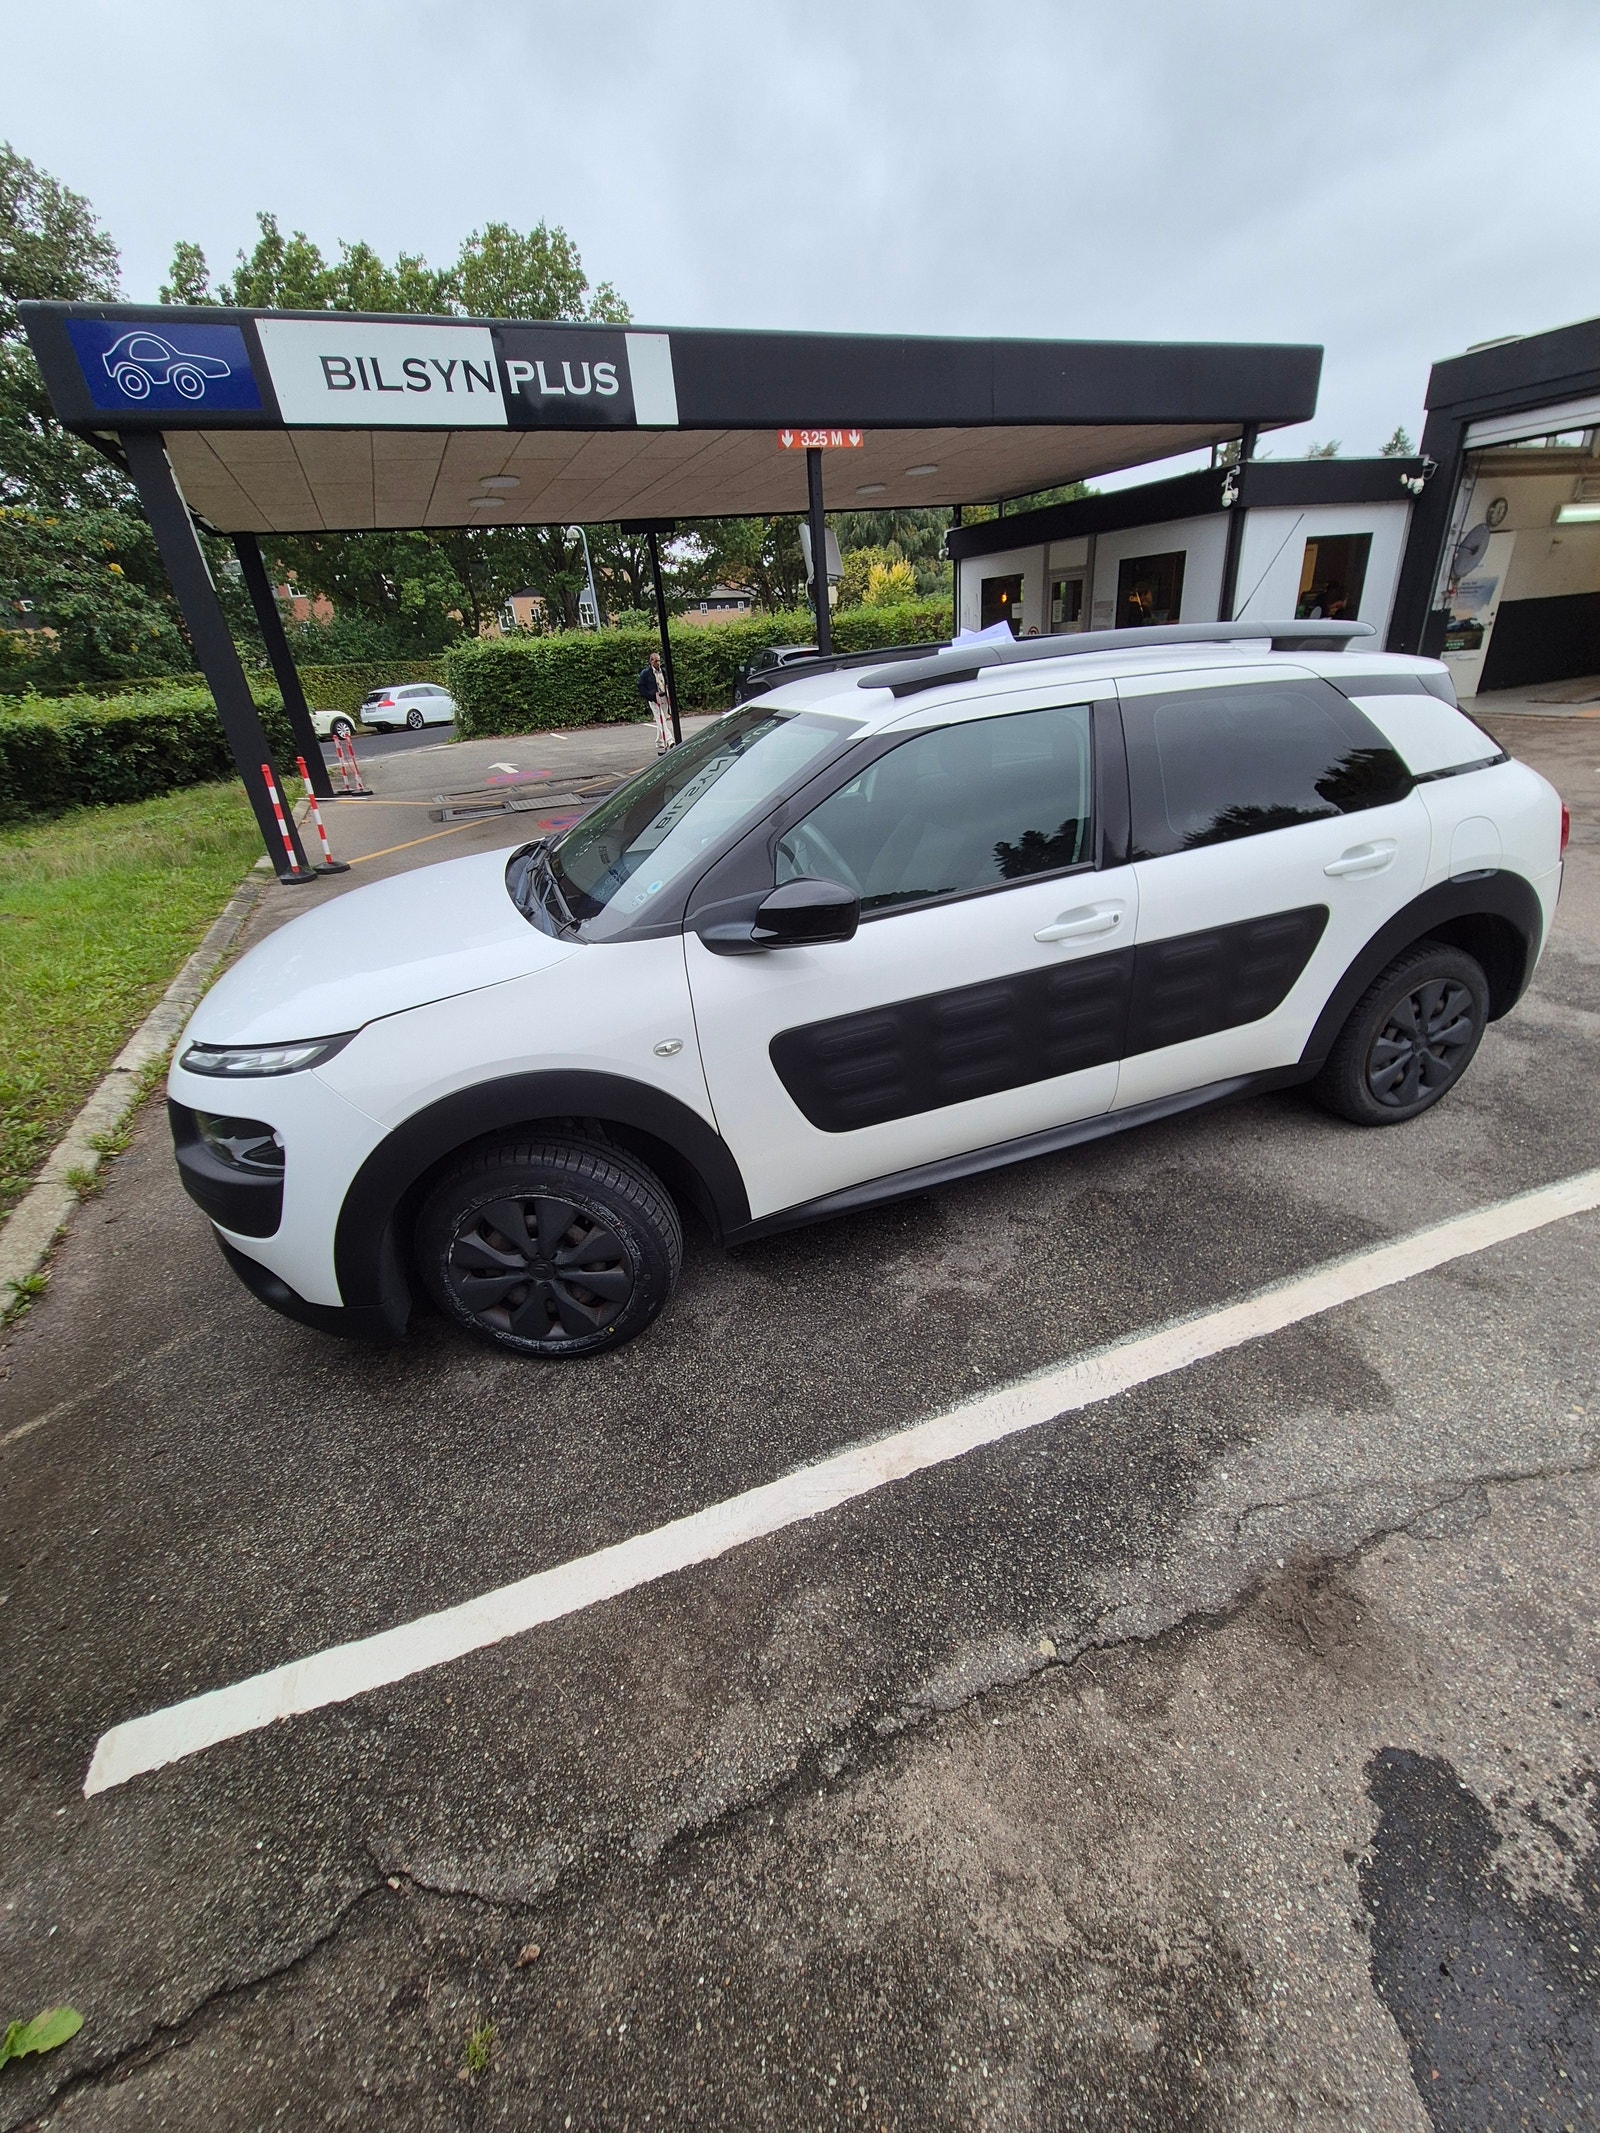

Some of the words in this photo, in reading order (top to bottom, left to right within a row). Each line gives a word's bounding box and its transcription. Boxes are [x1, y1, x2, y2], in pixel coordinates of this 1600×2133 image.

[319, 355, 497, 393] BILSYN
[505, 360, 619, 396] PLUS
[801, 431, 828, 446] 3.25
[831, 431, 843, 446] M
